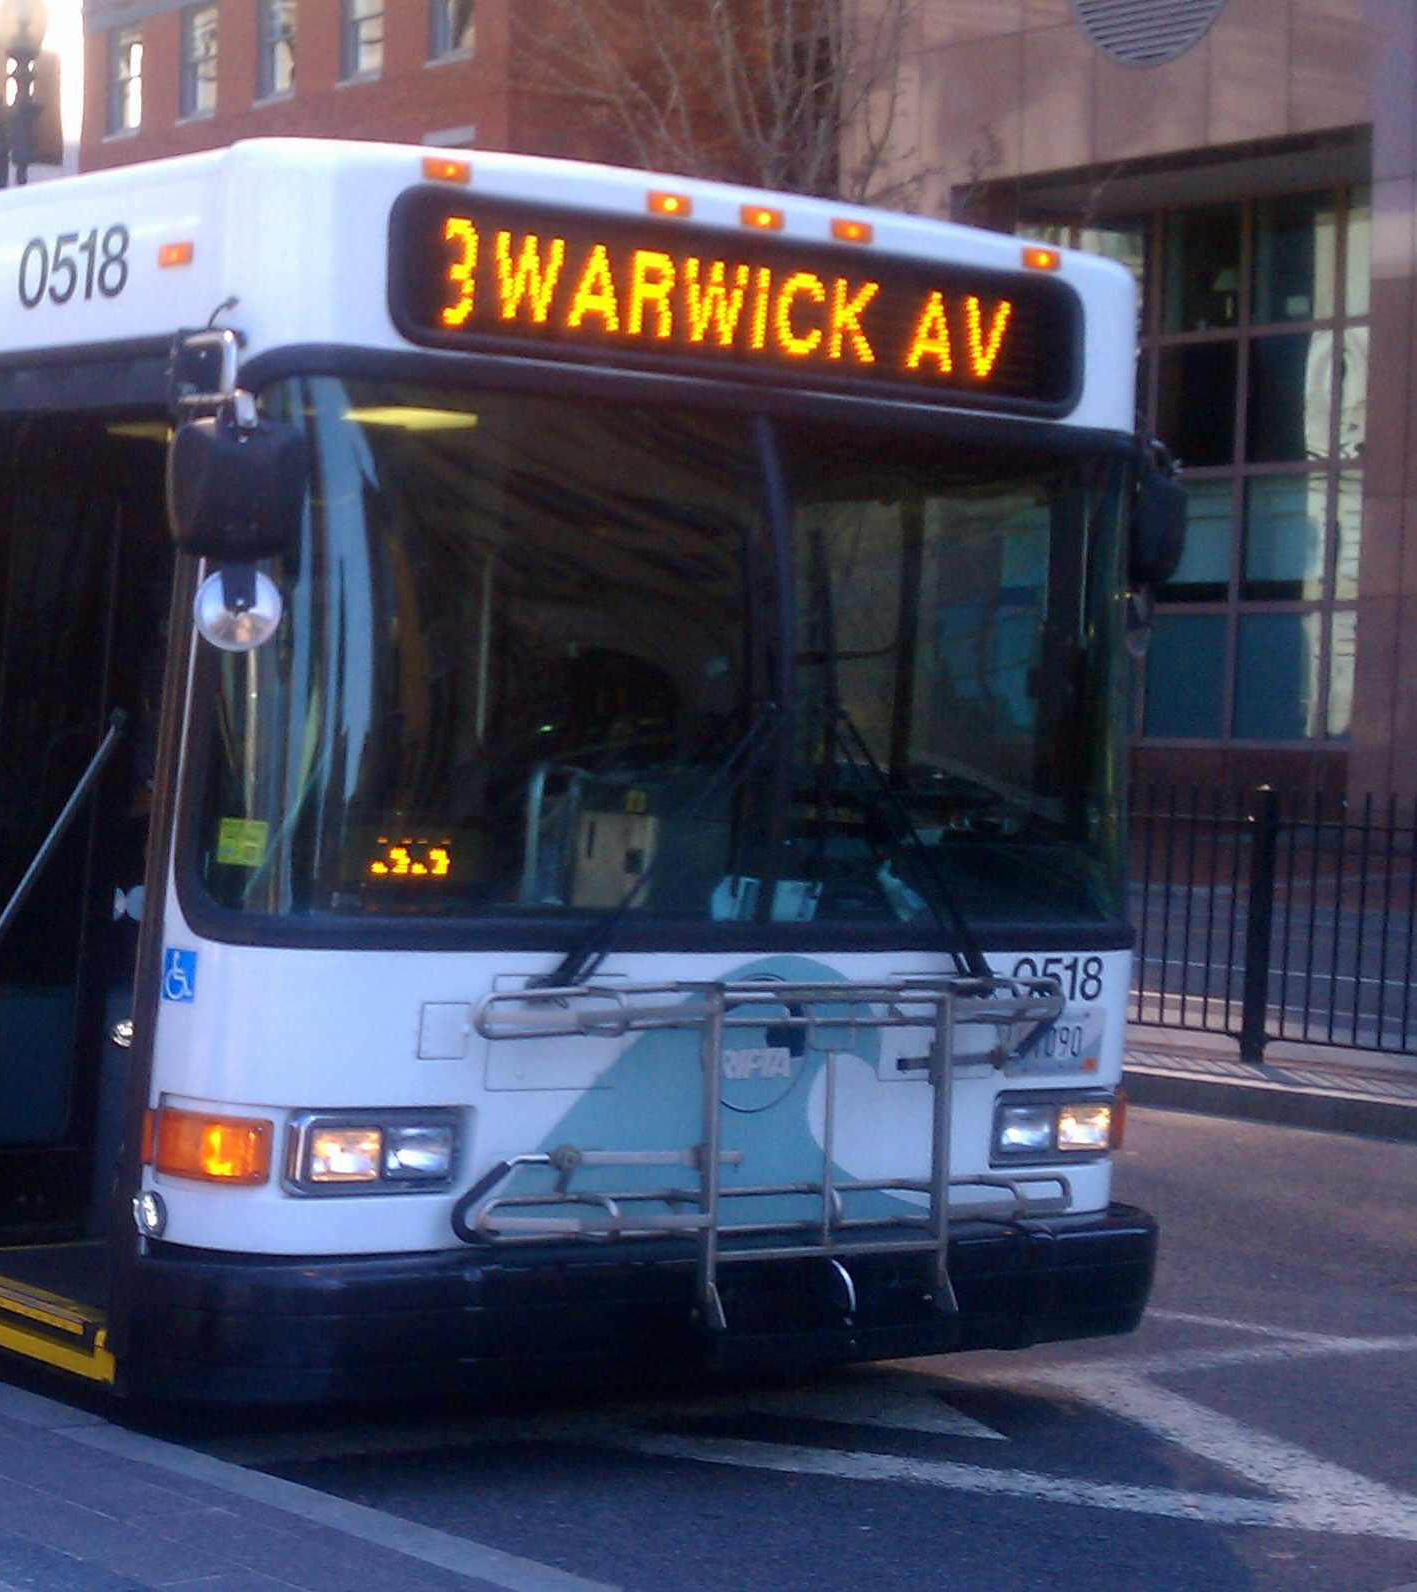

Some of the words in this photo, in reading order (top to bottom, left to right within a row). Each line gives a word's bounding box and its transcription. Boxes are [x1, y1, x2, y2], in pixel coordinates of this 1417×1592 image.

[17, 223, 130, 310] 0518
[441, 215, 479, 328] 3
[495, 229, 879, 364] WARWICK
[904, 290, 1012, 378] AV
